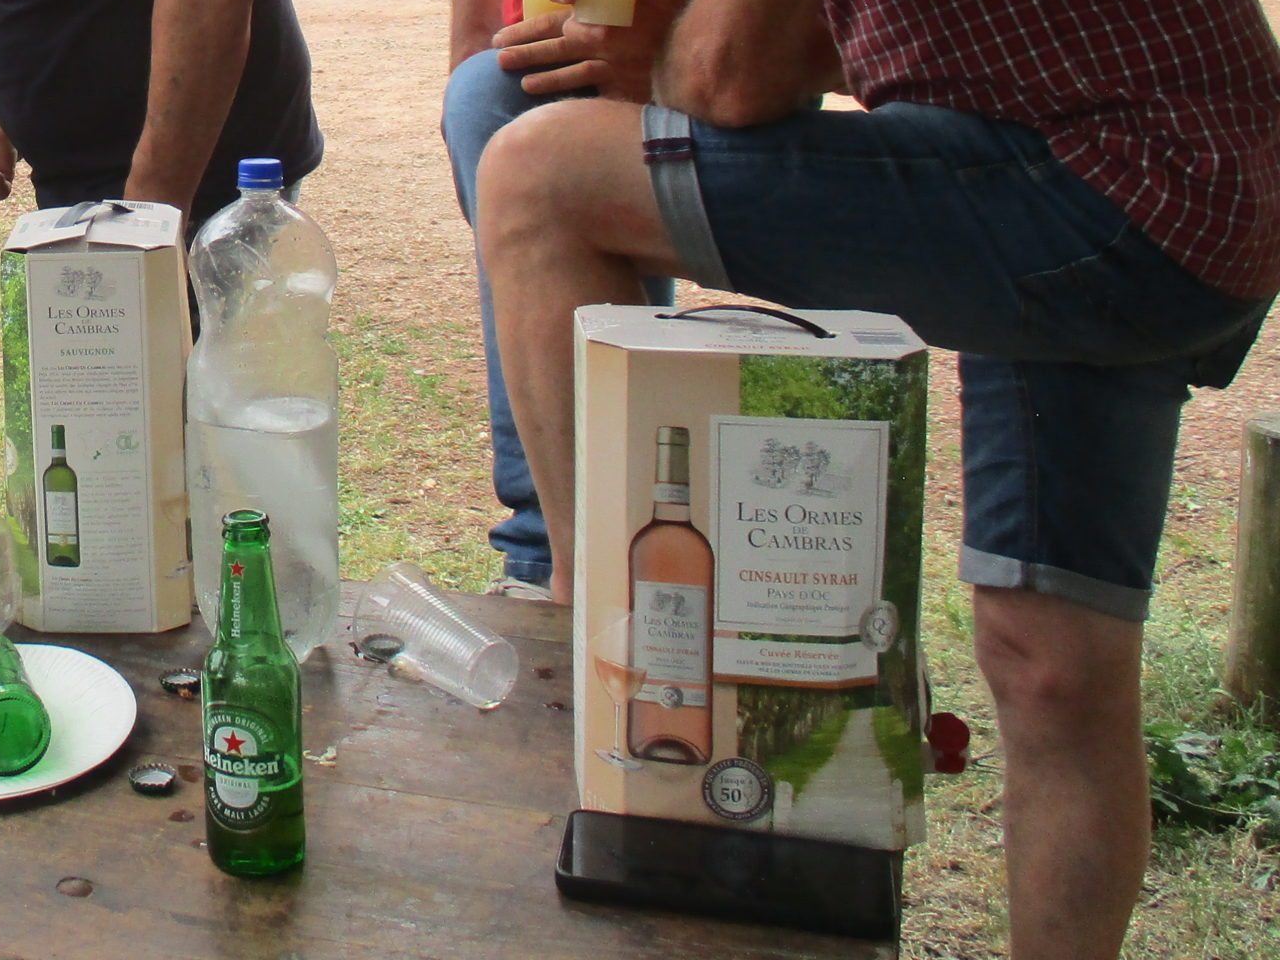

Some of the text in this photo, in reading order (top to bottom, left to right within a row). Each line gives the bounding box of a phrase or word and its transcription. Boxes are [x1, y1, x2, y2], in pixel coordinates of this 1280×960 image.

[48, 305, 126, 319] LES ORMES
[54, 321, 120, 335] CAMBRAS
[59, 347, 115, 357] SAUVIGNON
[736, 501, 864, 527] LES ORMES
[792, 526, 809, 535] DE
[747, 527, 853, 551] CAMBRAS
[738, 569, 859, 586] CINSAULT SYRAH
[766, 587, 795, 600] PAYS
[230, 580, 241, 639] Heineken
[759, 647, 840, 660] Cuvée Réservée
[235, 715, 270, 744] ORIGINAL
[204, 745, 280, 776] Heineken
[217, 776, 252, 789] ORIGINAL
[208, 785, 271, 821] PURE MALT LAGER
[719, 787, 742, 803] 50
